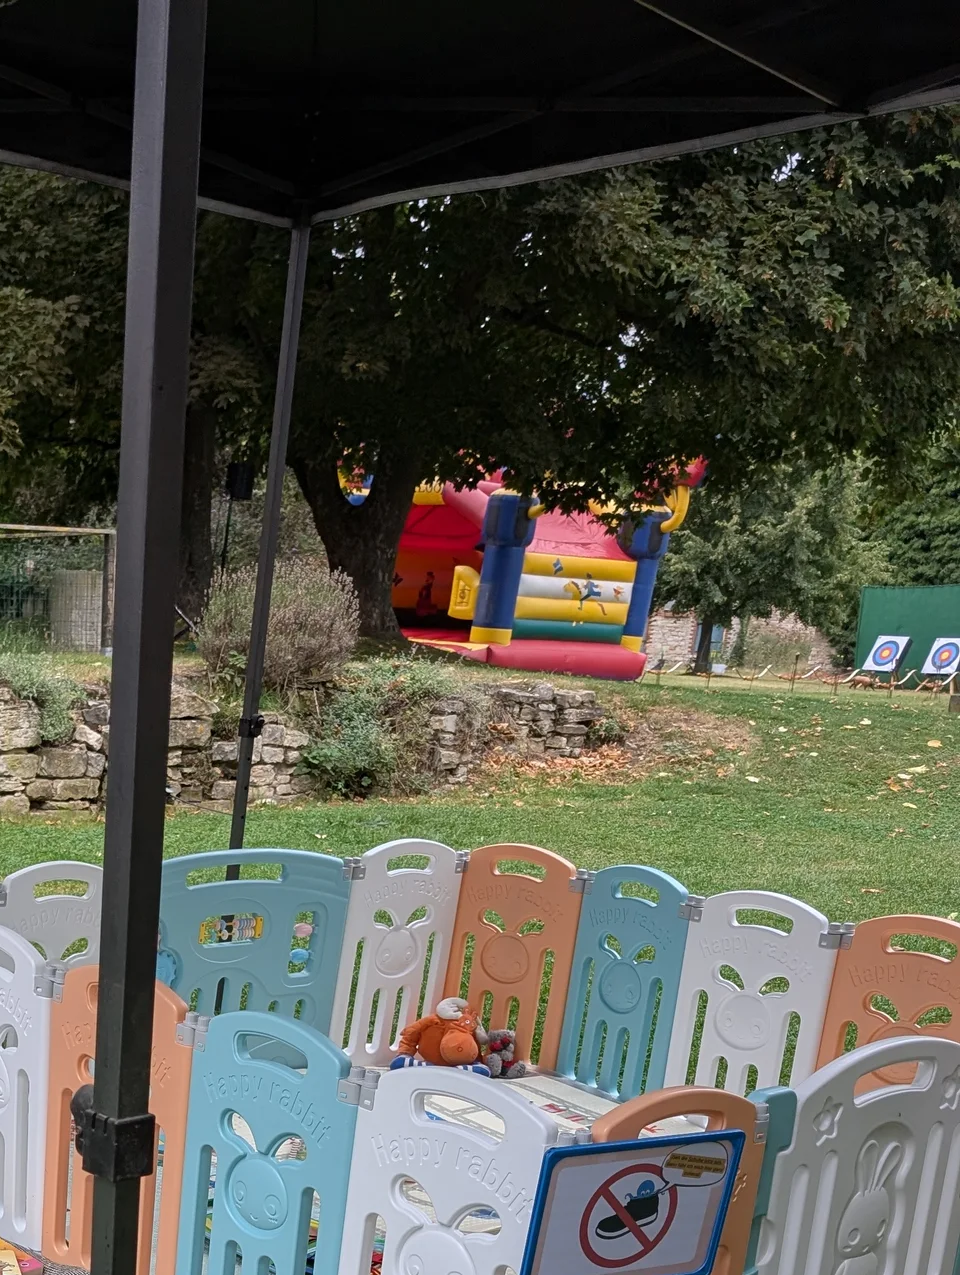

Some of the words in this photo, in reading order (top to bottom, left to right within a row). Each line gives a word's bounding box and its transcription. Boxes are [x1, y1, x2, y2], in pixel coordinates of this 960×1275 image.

[465, 882, 513, 905] Happy
[588, 907, 630, 928] Happy
[848, 963, 910, 988] Happy
[203, 1071, 264, 1104] Happy
[268, 1080, 332, 1150] rabbit
[369, 1132, 448, 1169] Happy
[454, 1145, 533, 1225] rabbit
